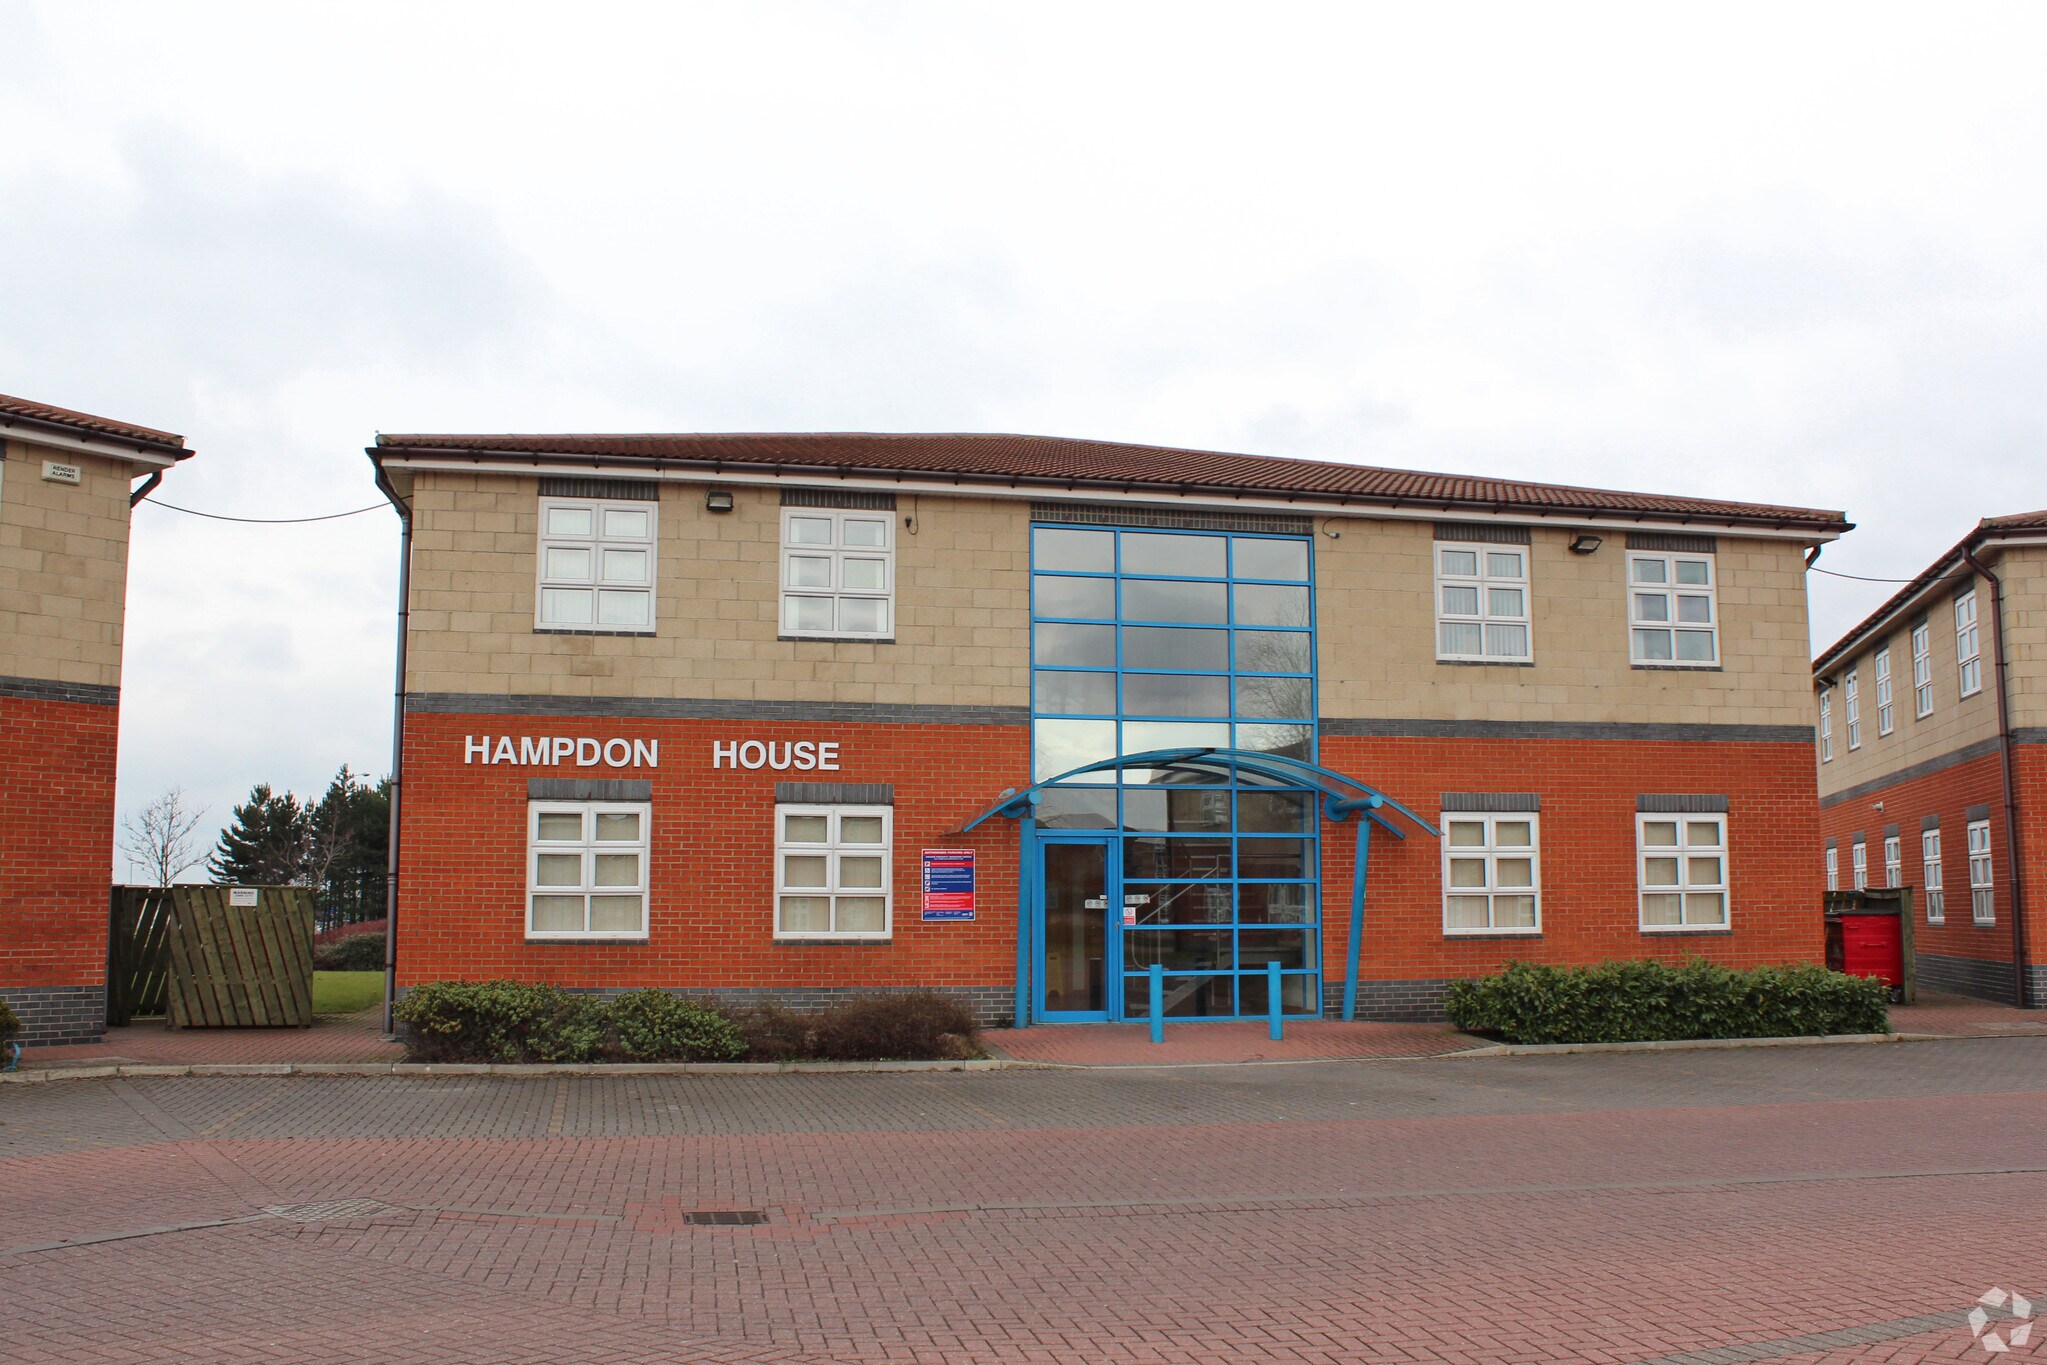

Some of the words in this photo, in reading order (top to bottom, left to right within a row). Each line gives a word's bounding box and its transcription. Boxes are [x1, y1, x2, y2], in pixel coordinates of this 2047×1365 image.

[52, 471, 75, 479] ALARMS
[464, 735, 658, 768] HAMPDON
[713, 740, 840, 771] HOUSE
